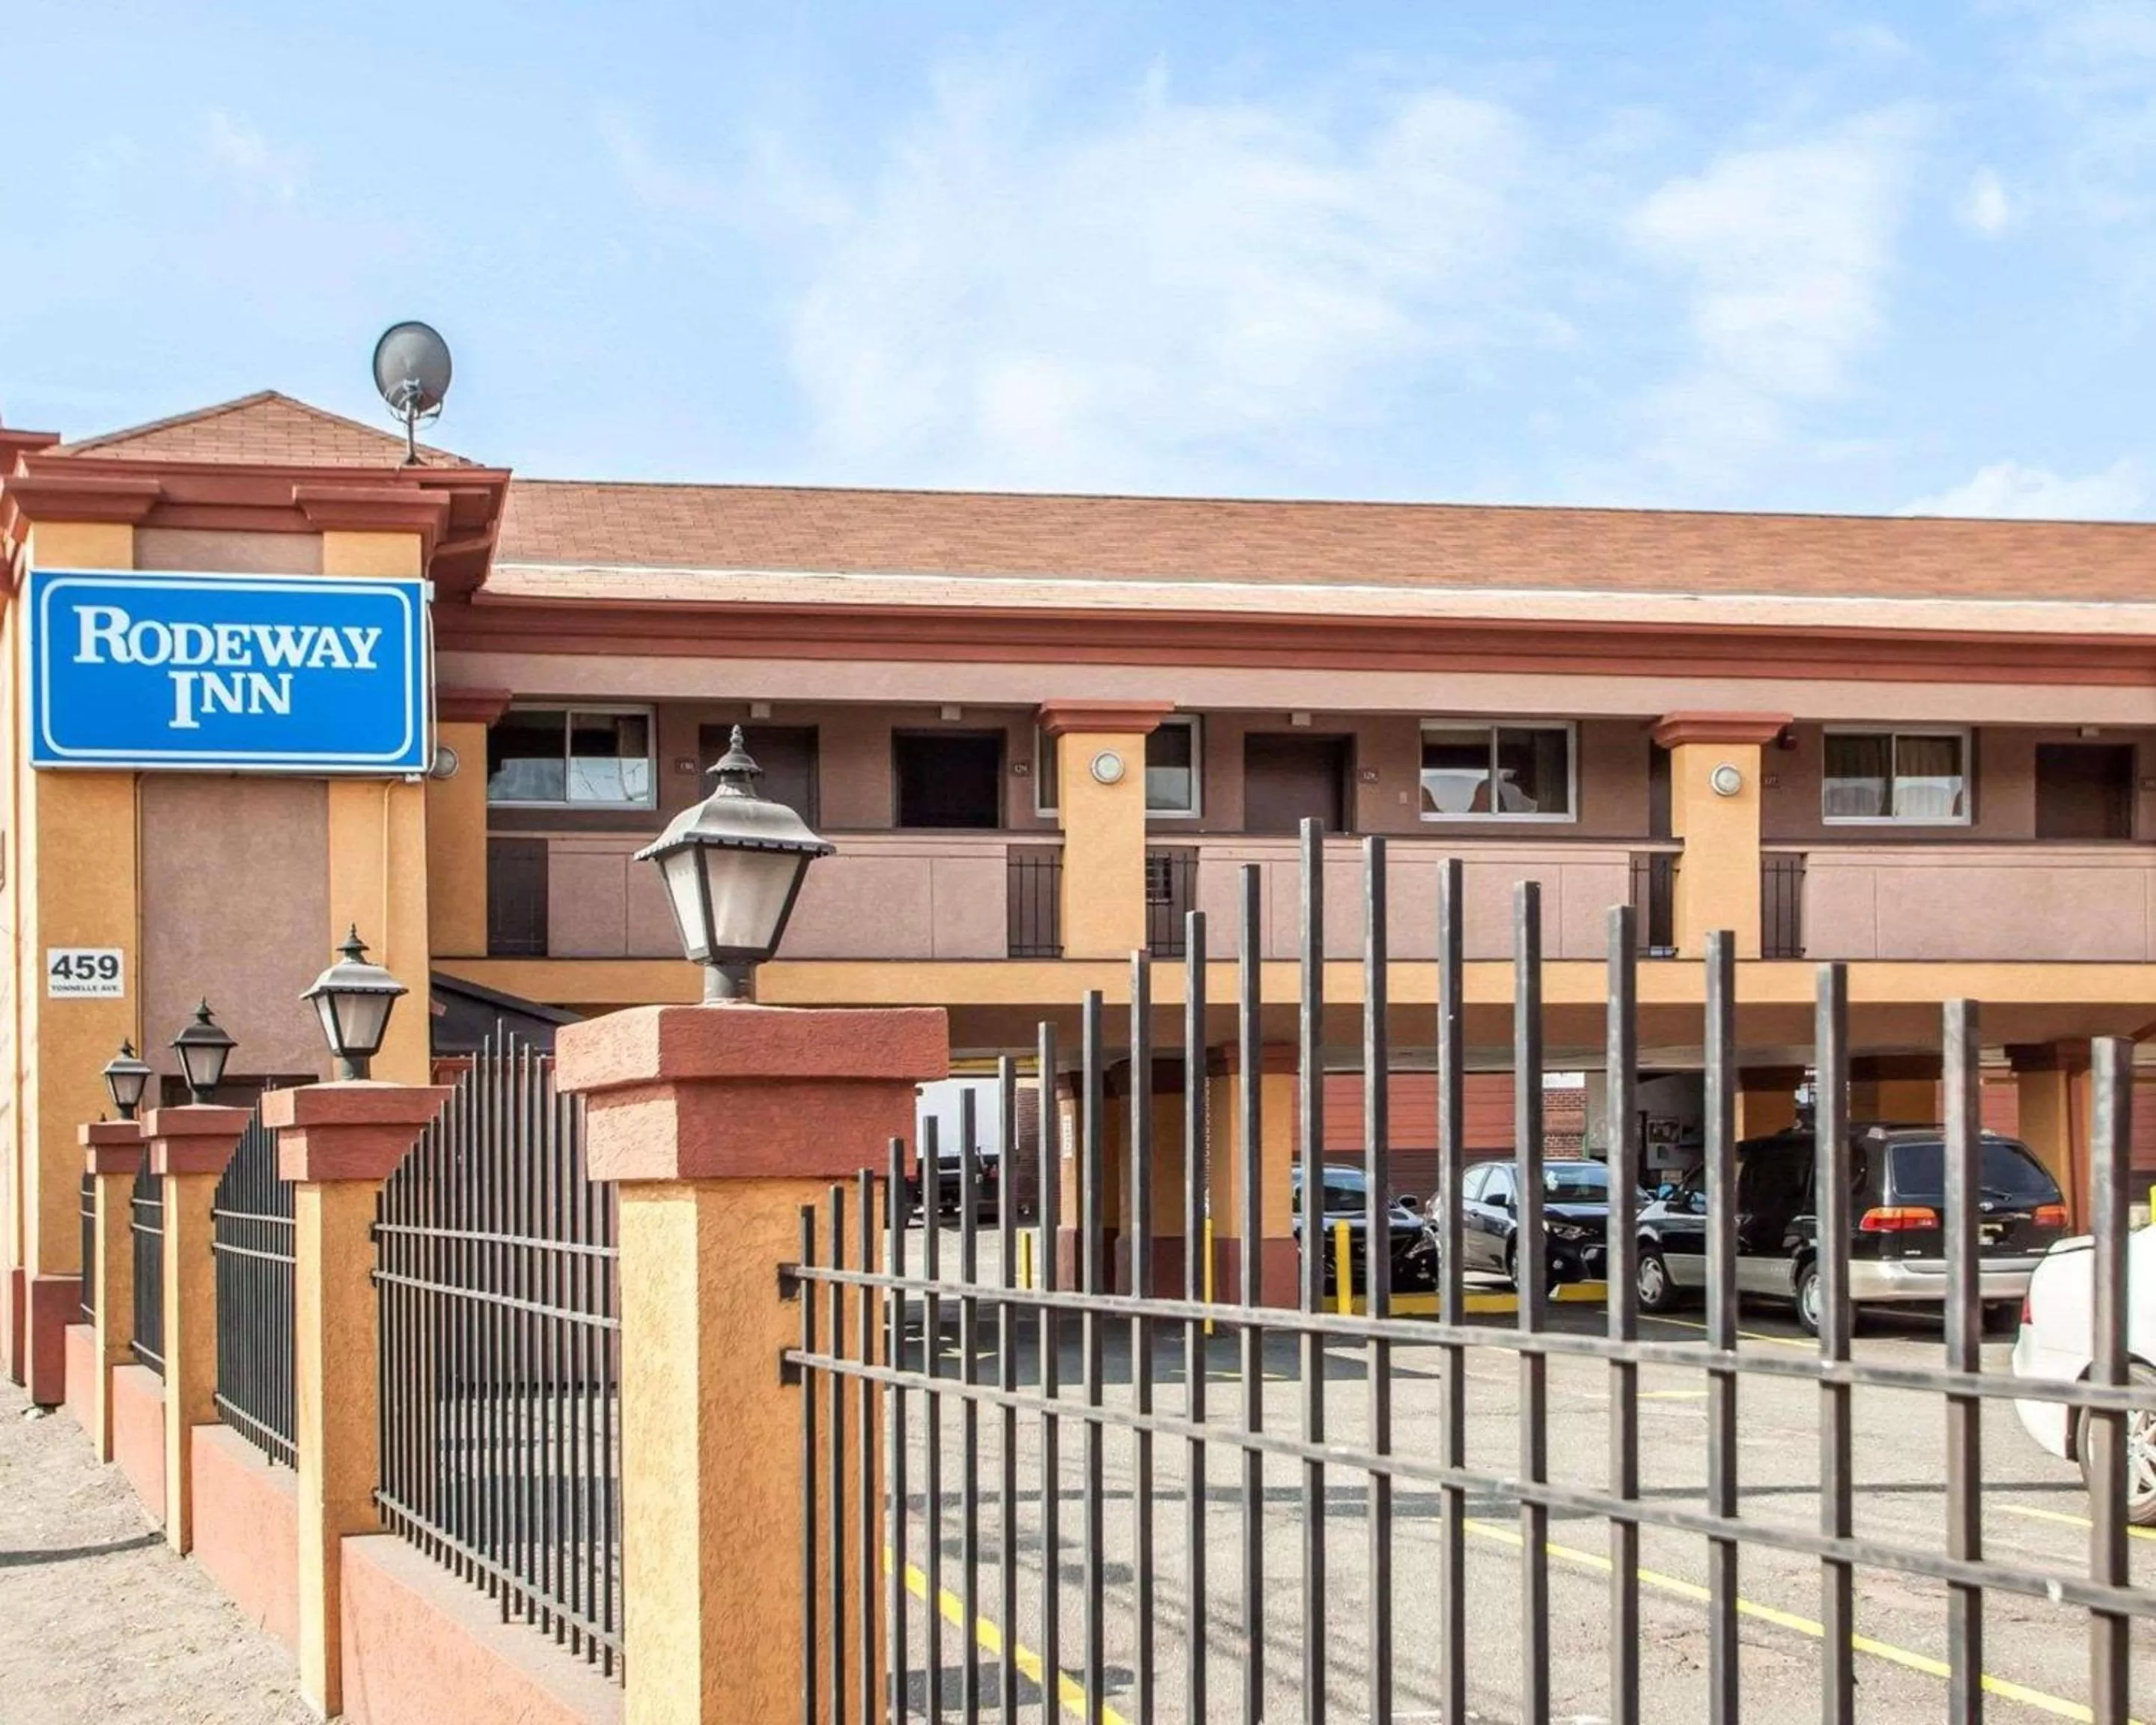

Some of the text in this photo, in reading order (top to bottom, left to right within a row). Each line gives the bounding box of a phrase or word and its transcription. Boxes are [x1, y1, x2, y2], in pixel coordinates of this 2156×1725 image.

[73, 605, 383, 669] RODEWAY
[168, 671, 293, 728] INN
[52, 955, 119, 980] 459
